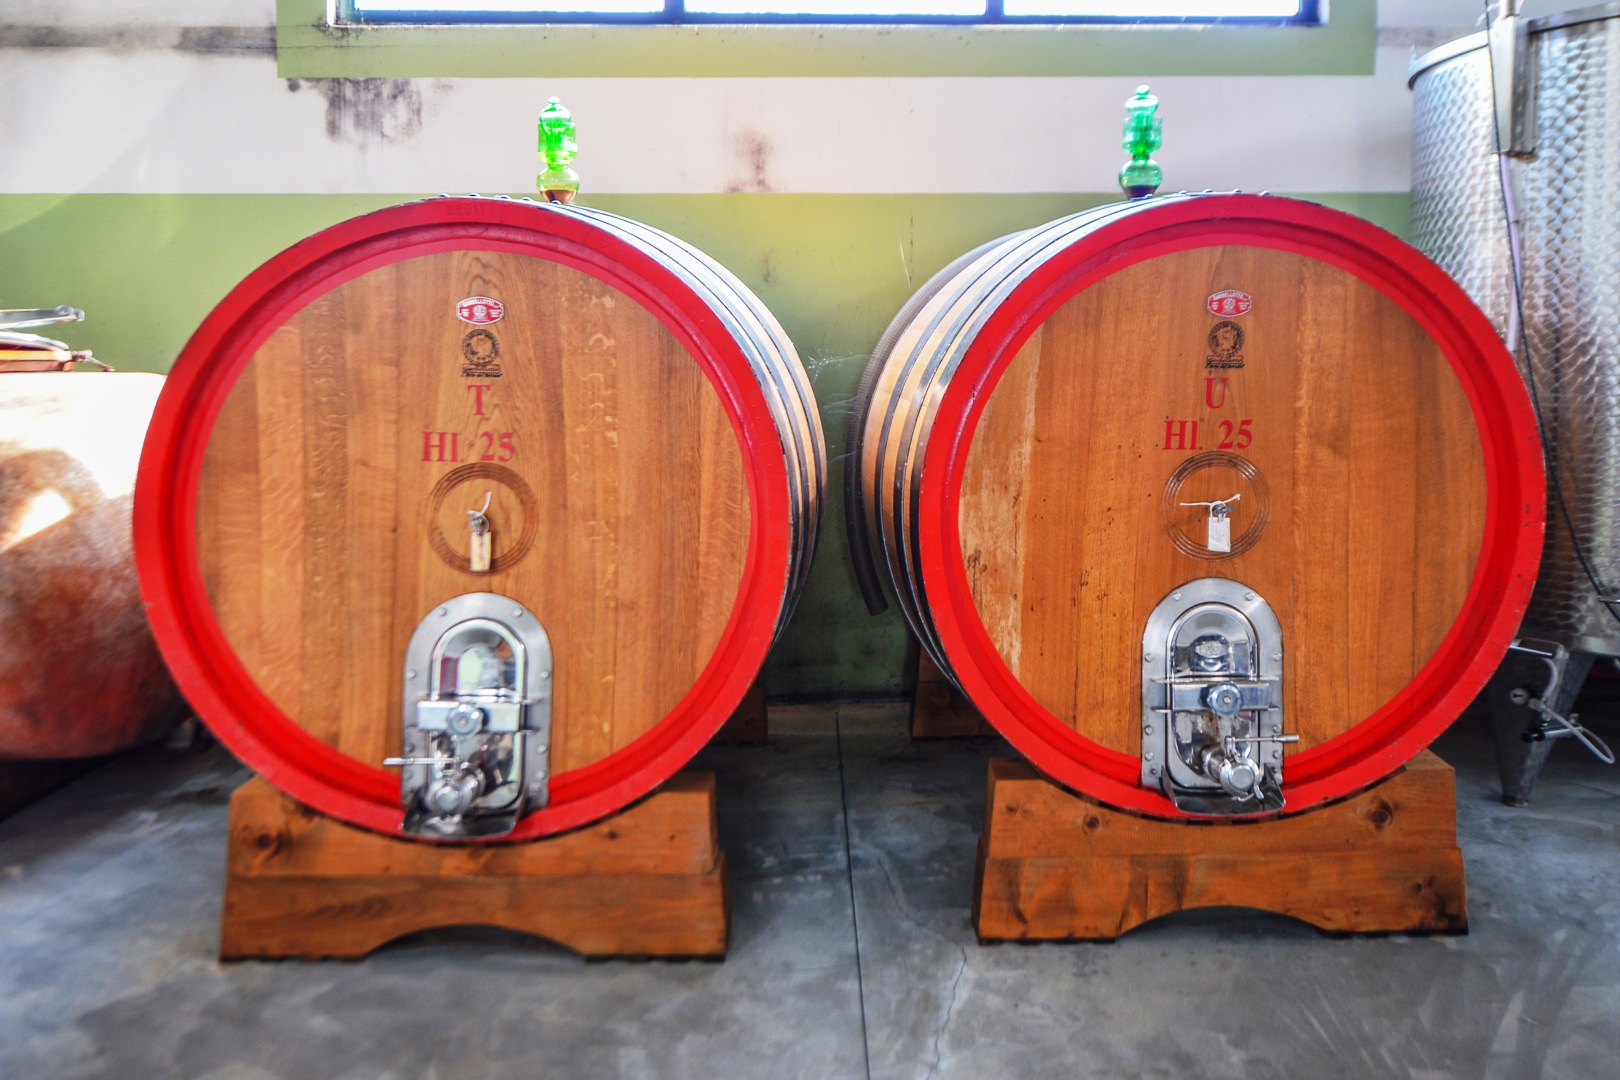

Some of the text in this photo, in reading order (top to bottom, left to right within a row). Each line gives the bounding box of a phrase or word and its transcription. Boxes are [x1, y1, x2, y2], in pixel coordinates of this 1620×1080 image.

[467, 384, 491, 416] T
[1204, 377, 1229, 409] U
[479, 431, 515, 462] 25
[1217, 419, 1253, 449] 25
